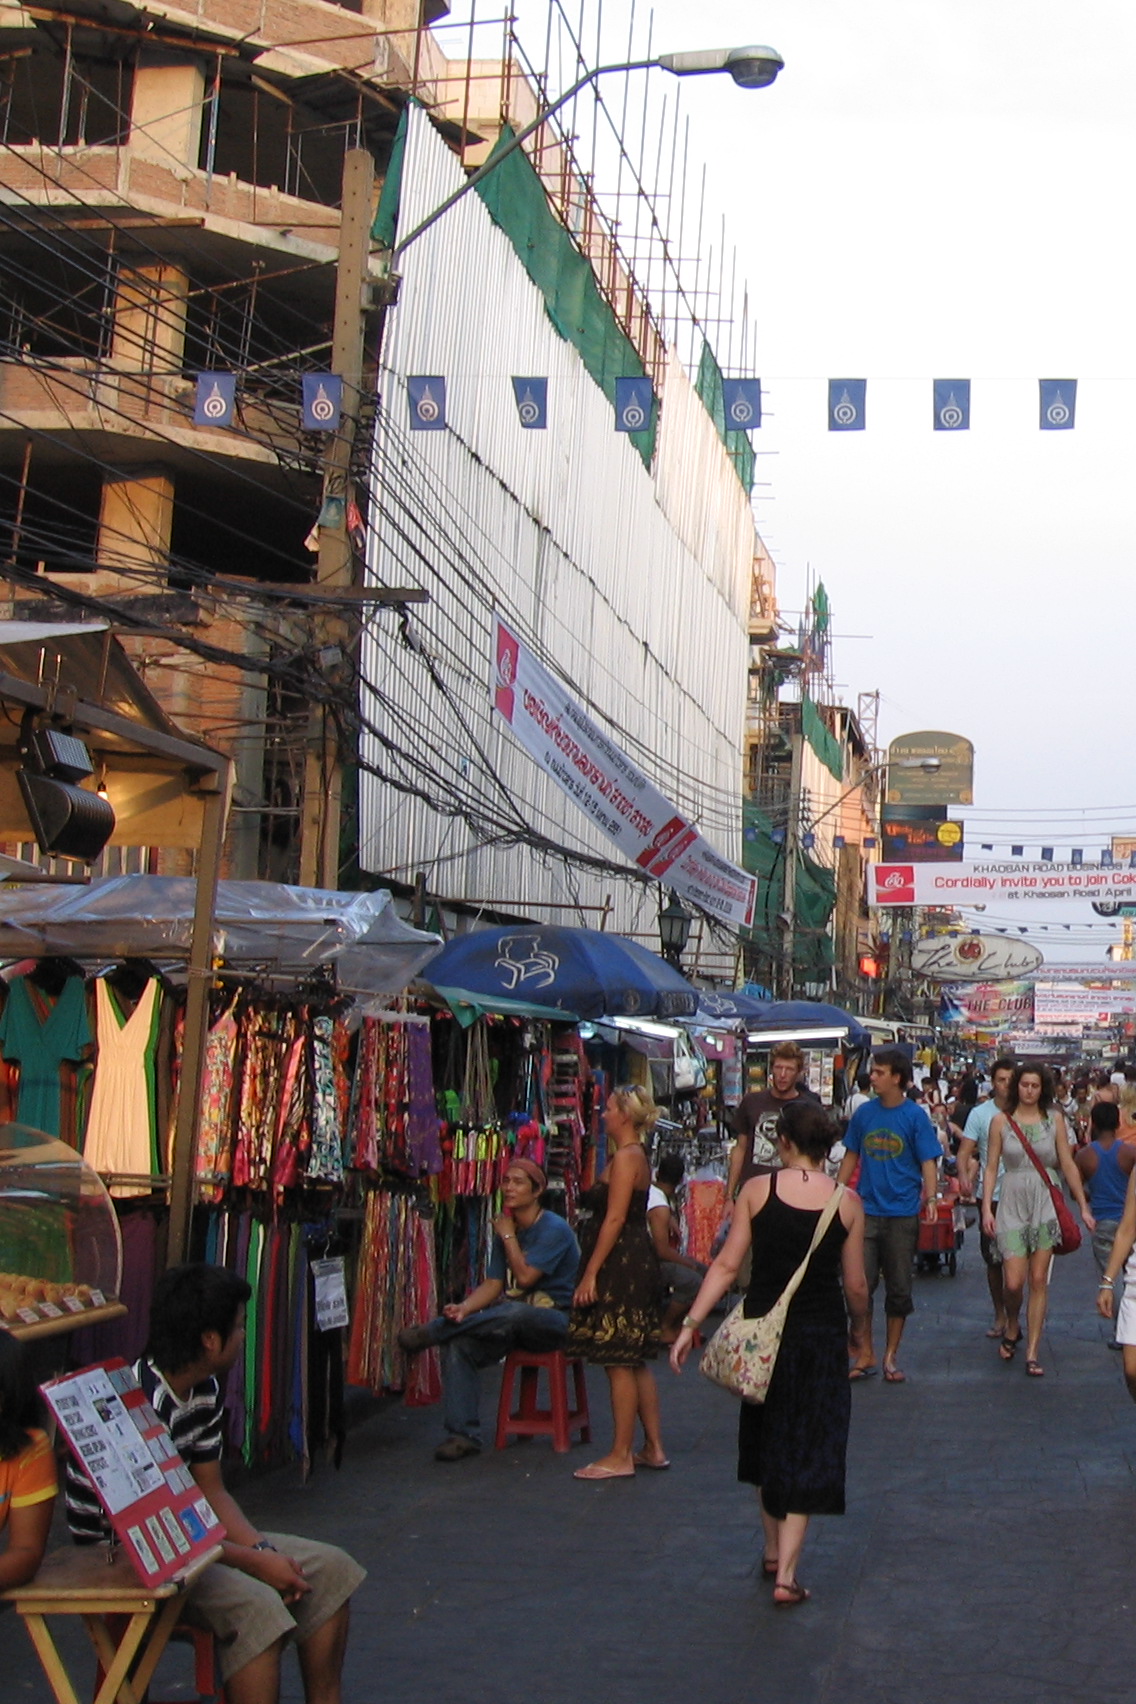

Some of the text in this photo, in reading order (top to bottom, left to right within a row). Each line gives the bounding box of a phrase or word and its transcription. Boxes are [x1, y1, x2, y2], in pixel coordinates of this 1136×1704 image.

[973, 864, 1030, 874] KHAOSAN
[1033, 863, 1064, 873] ROAD
[934, 876, 995, 890] Cordially
[1041, 877, 1064, 889] you
[1068, 875, 1082, 886] to
[1085, 874, 1107, 888] join
[1007, 891, 1019, 899] at
[1023, 890, 1070, 899] Khaosan
[1073, 888, 1100, 897] Road
[1105, 887, 1132, 898] April
[918, 944, 958, 970] The
[967, 998, 1031, 1011] THE CLUB
